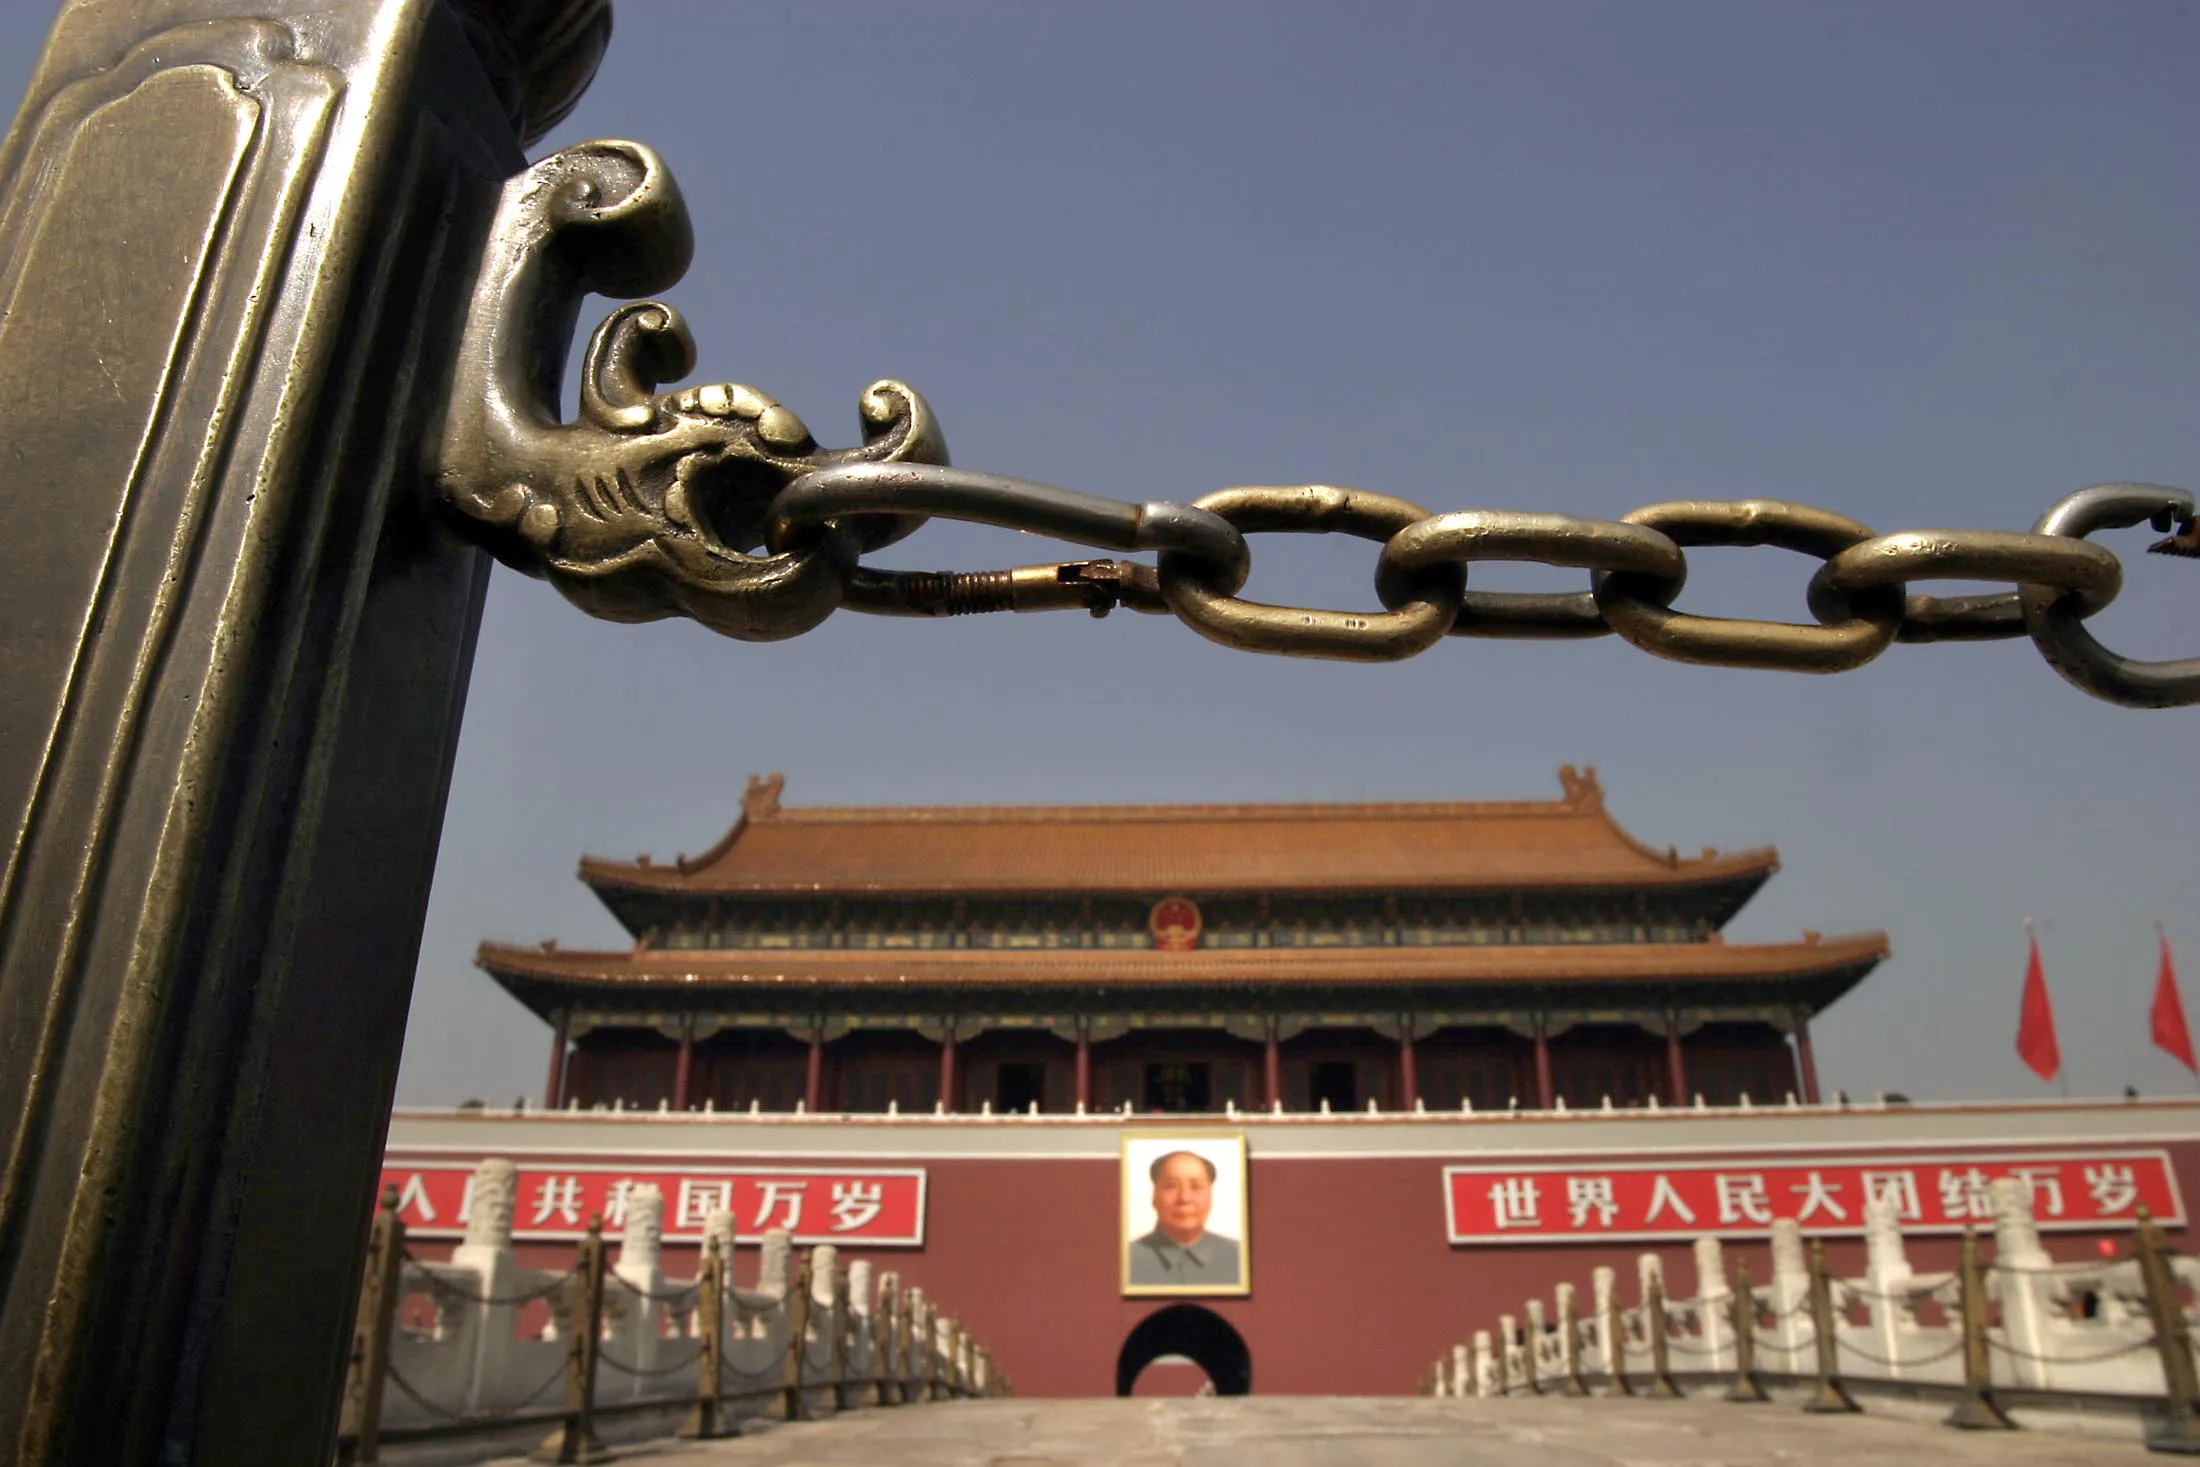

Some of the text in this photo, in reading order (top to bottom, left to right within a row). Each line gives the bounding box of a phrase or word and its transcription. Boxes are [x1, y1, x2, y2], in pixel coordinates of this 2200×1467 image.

[396, 1173, 882, 1231] 人共国万岁
[1488, 1165, 2137, 1228] 世界人民大团结万岁
